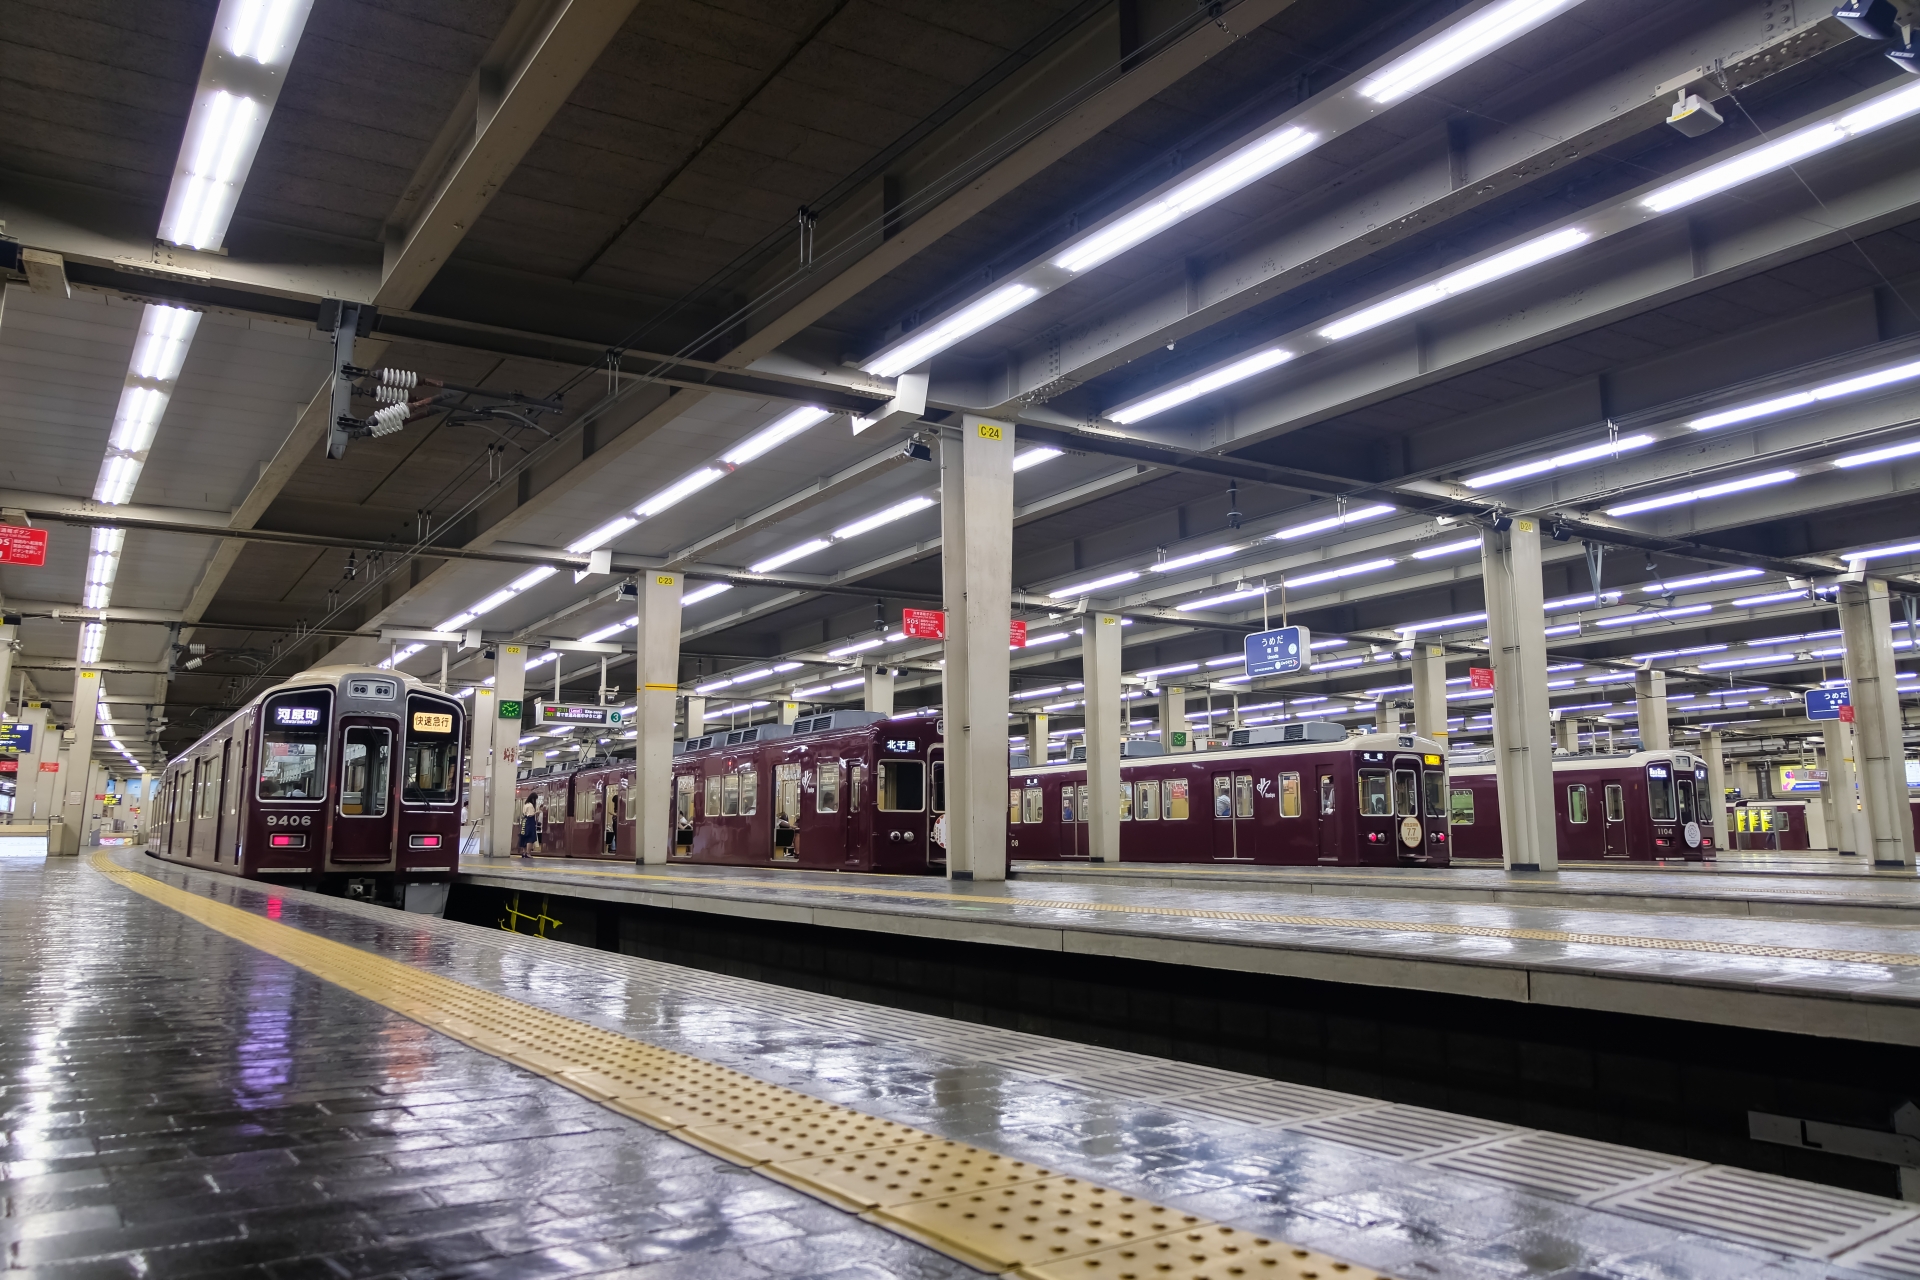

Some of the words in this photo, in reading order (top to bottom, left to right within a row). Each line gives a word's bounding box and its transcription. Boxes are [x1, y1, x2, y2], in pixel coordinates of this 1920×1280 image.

[980, 425, 1000, 438] C-24
[1261, 634, 1284, 647] うめだ
[1824, 691, 1848, 700] うめだ
[277, 708, 319, 721] 河原町
[612, 709, 620, 718] 3
[415, 715, 449, 728] 快速急行
[886, 739, 916, 750] 北千里
[266, 814, 312, 827] 9406
[1406, 827, 1417, 837] 7.7
[1656, 827, 1673, 835] 1104
